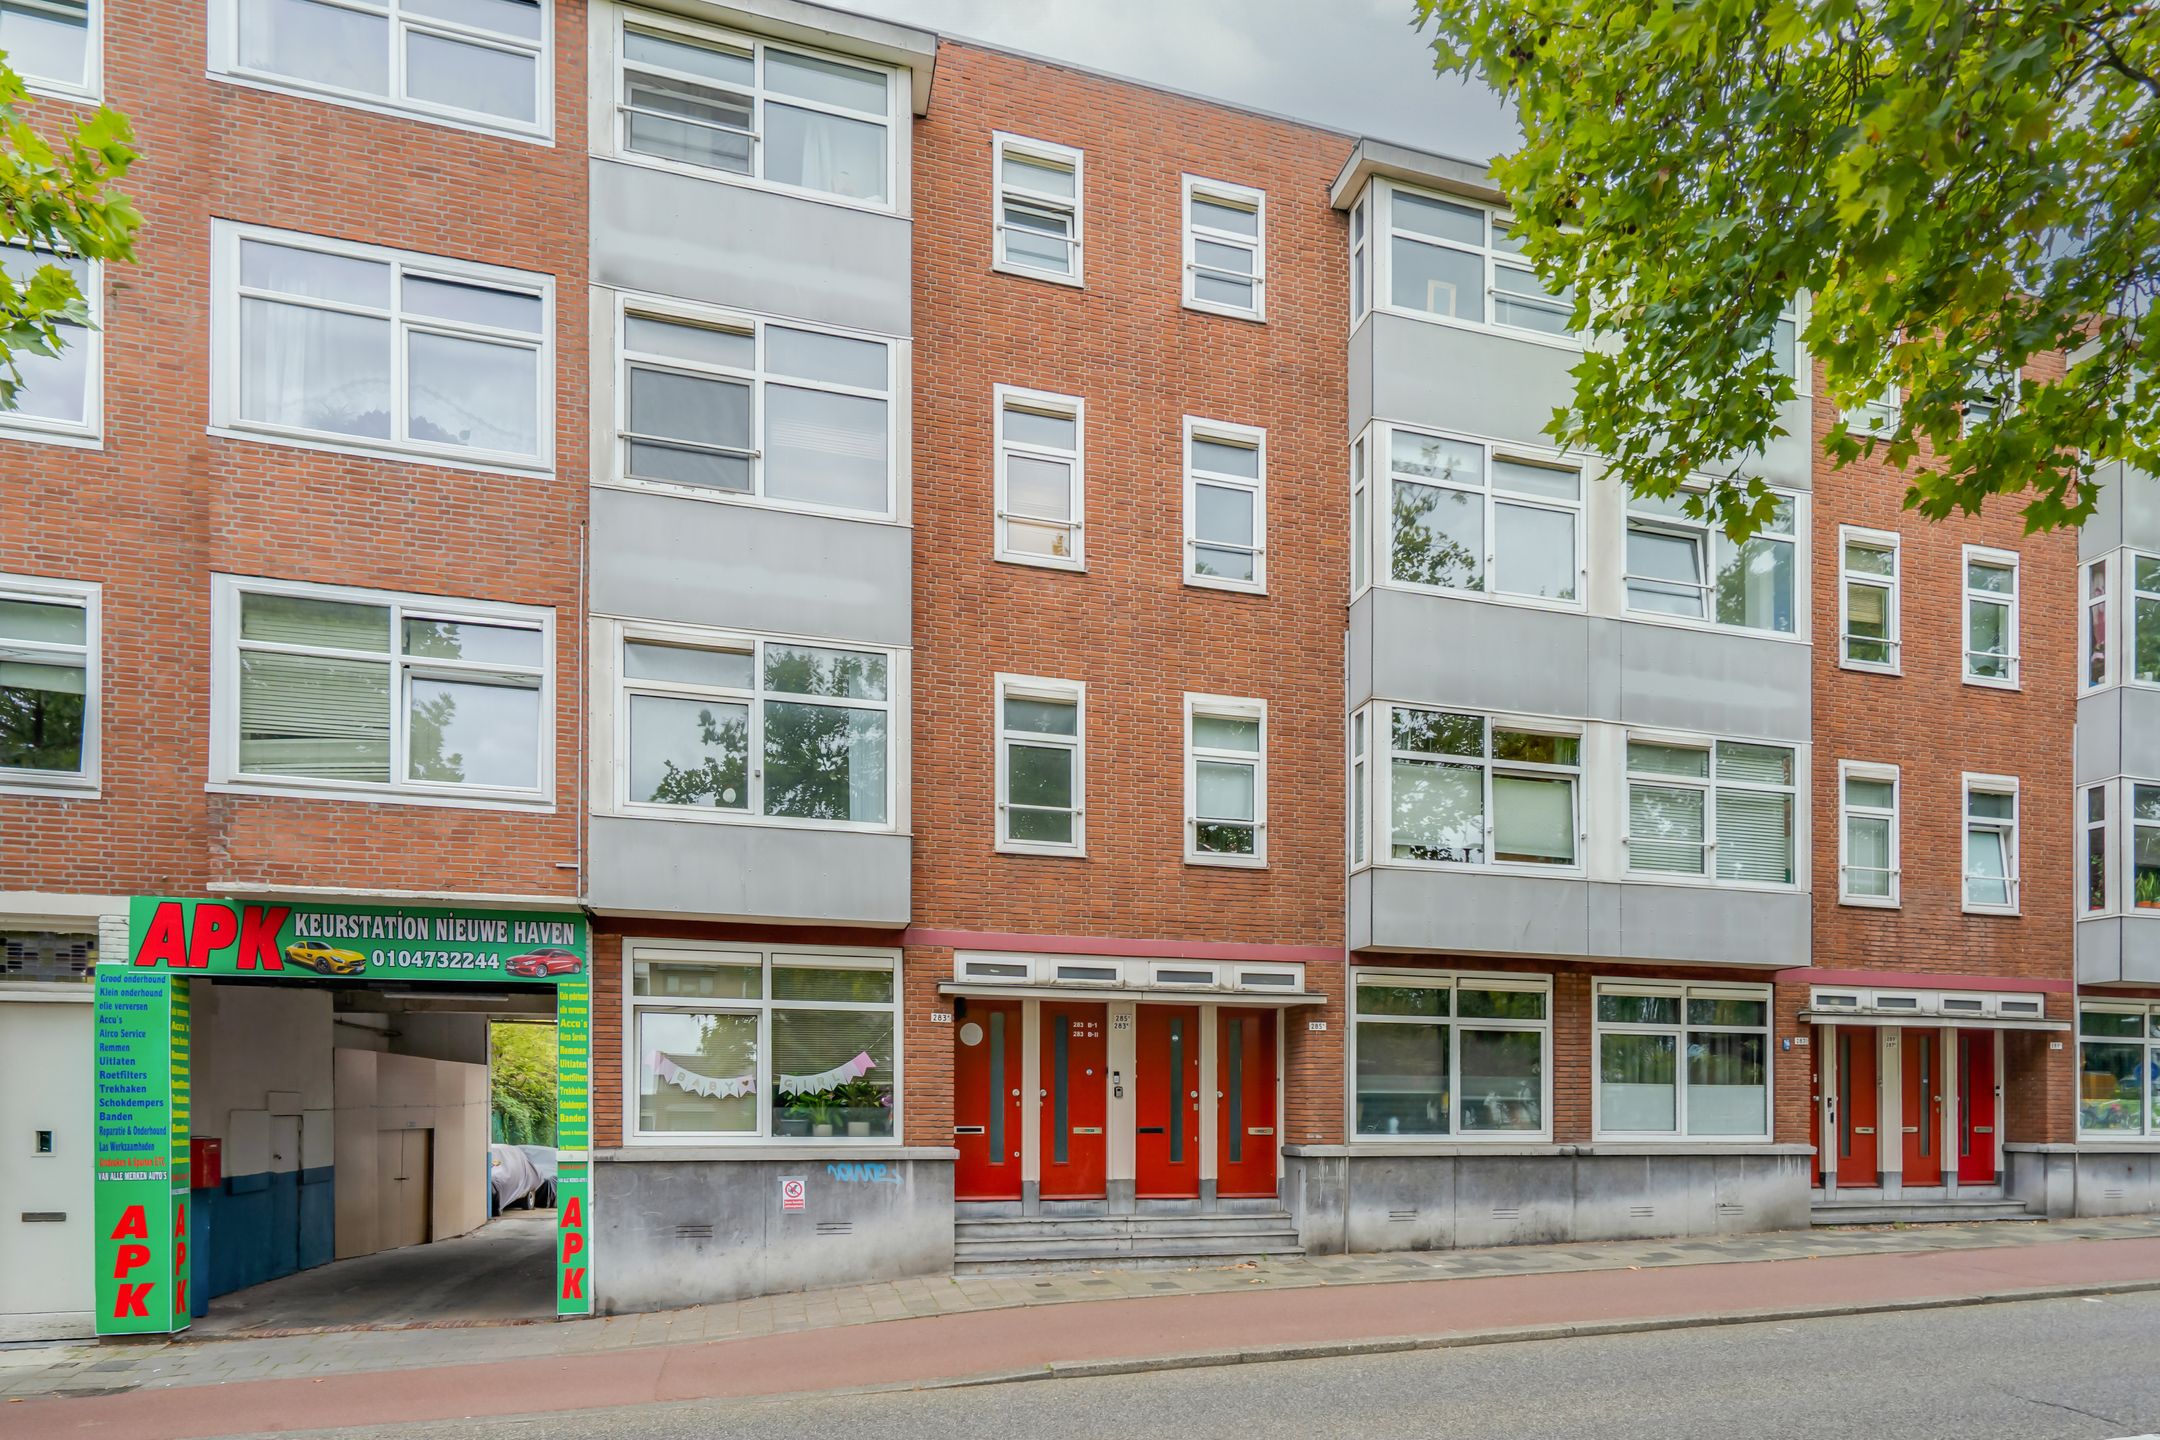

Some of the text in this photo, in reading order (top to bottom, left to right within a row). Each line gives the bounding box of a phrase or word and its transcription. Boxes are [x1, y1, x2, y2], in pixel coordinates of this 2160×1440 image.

[134, 902, 291, 970] APK
[514, 921, 575, 945] HAVEN
[371, 949, 500, 969] 0104732244
[99, 988, 118, 997] Klein
[99, 1002, 113, 1010] olie
[99, 1015, 122, 1024] Accu's
[99, 1029, 146, 1038] Airco Service
[99, 1043, 130, 1052] Remmen
[99, 1057, 136, 1066] Uitlaten
[99, 1070, 147, 1080] Roetfilters
[677, 1071, 840, 1091] BABY GIRL
[99, 1084, 147, 1093] Trekhaken
[99, 1098, 164, 1108] Schokdempers
[99, 1112, 133, 1121] Banden
[560, 1196, 586, 1299] APK
[110, 1205, 155, 1318] APK
[175, 1203, 187, 1315] APK
